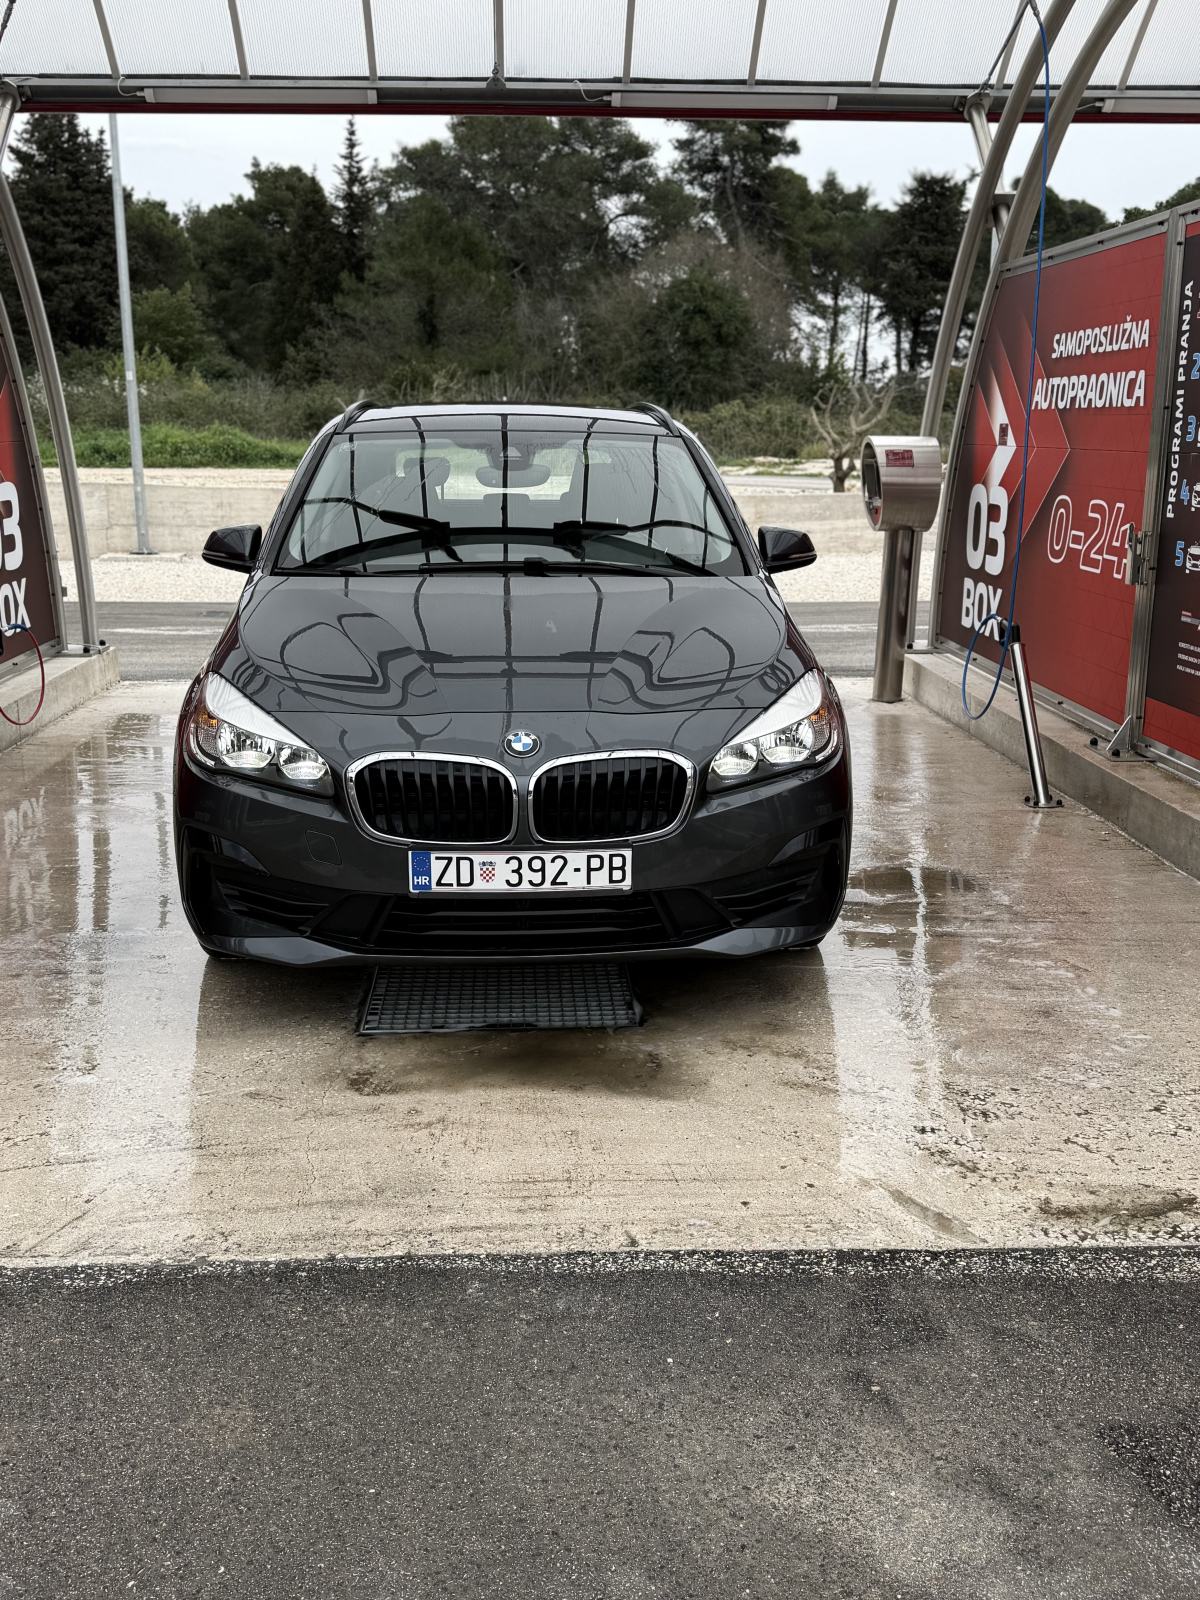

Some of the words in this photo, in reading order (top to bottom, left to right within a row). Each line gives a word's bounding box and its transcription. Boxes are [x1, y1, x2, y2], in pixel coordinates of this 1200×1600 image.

[1051, 314, 1150, 359] SAMOPOSLUŽNA
[1191, 353, 1200, 380] 2
[1031, 369, 1145, 410] AUTOPRAONICA
[1166, 389, 1185, 518] PROGRAMI
[1178, 280, 1194, 382] PRANJA
[1186, 415, 1196, 442] 3
[1180, 479, 1190, 506] 4
[0, 481, 23, 571] 3
[966, 483, 1009, 576] 03
[1047, 494, 1131, 580] 0-24
[1174, 540, 1184, 567] 5
[0, 577, 31, 637] OX
[961, 577, 1003, 641] BOX
[413, 875, 430, 886] HR
[434, 856, 475, 887] ZD
[504, 853, 627, 888] 392-PB
